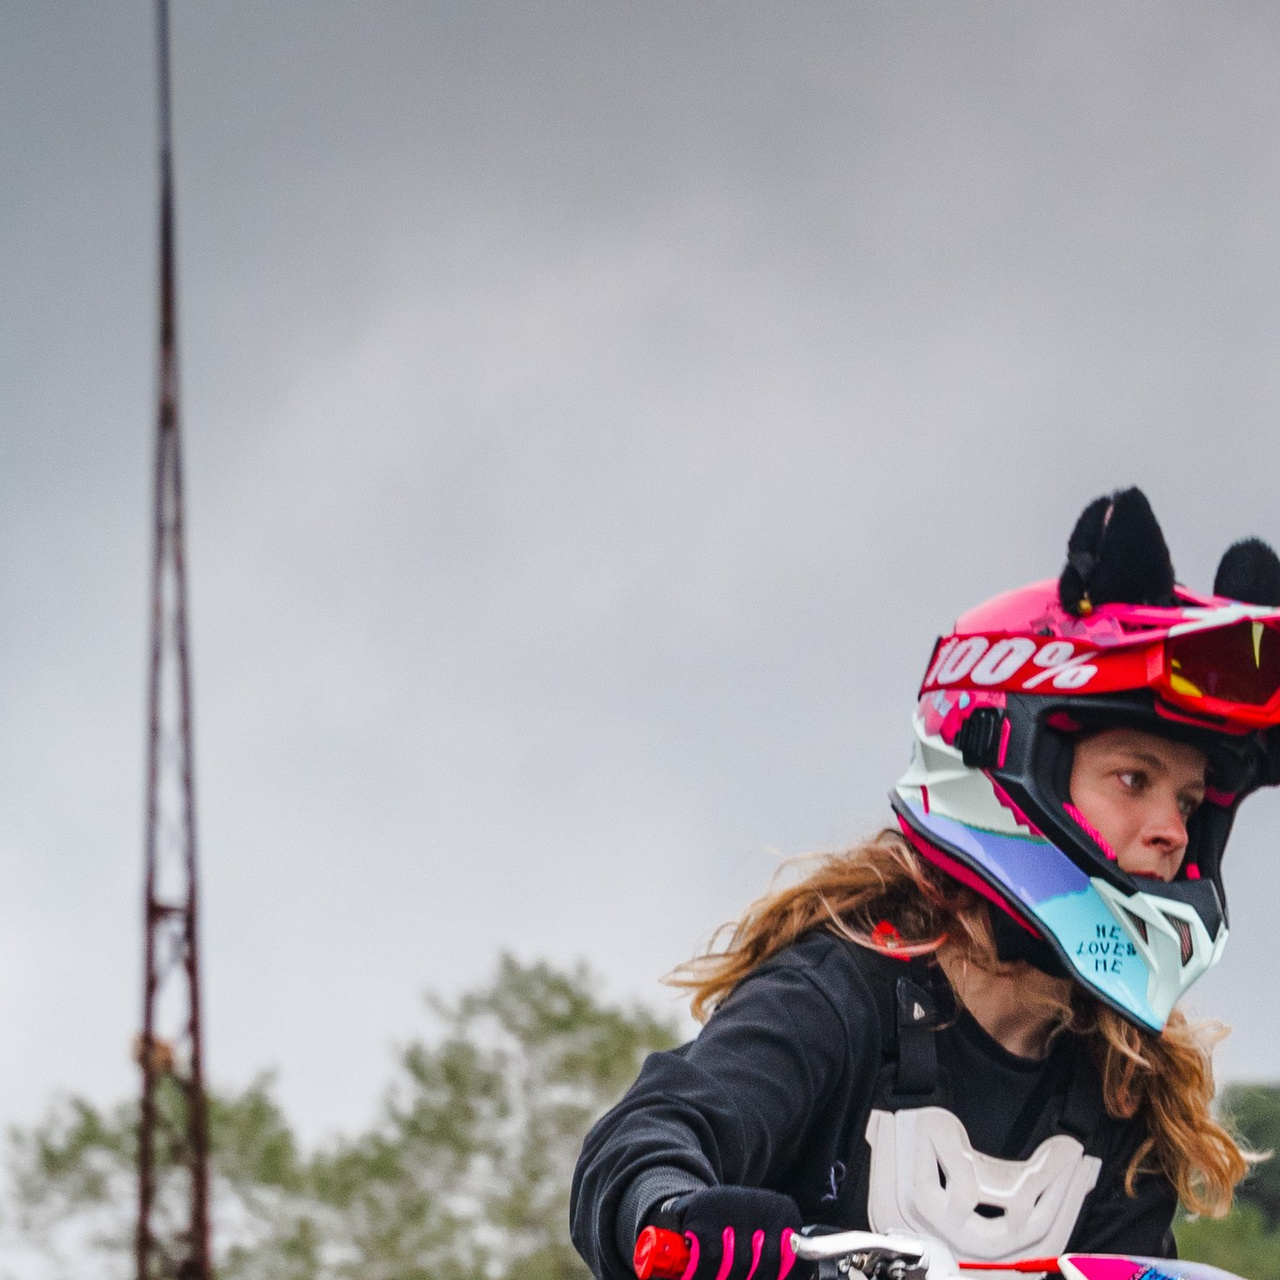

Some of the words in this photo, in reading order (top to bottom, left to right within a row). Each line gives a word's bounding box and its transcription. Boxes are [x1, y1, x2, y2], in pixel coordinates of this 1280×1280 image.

[924, 636, 1098, 689] 100%
[1096, 924, 1121, 940] HE
[1095, 958, 1122, 974] ME
